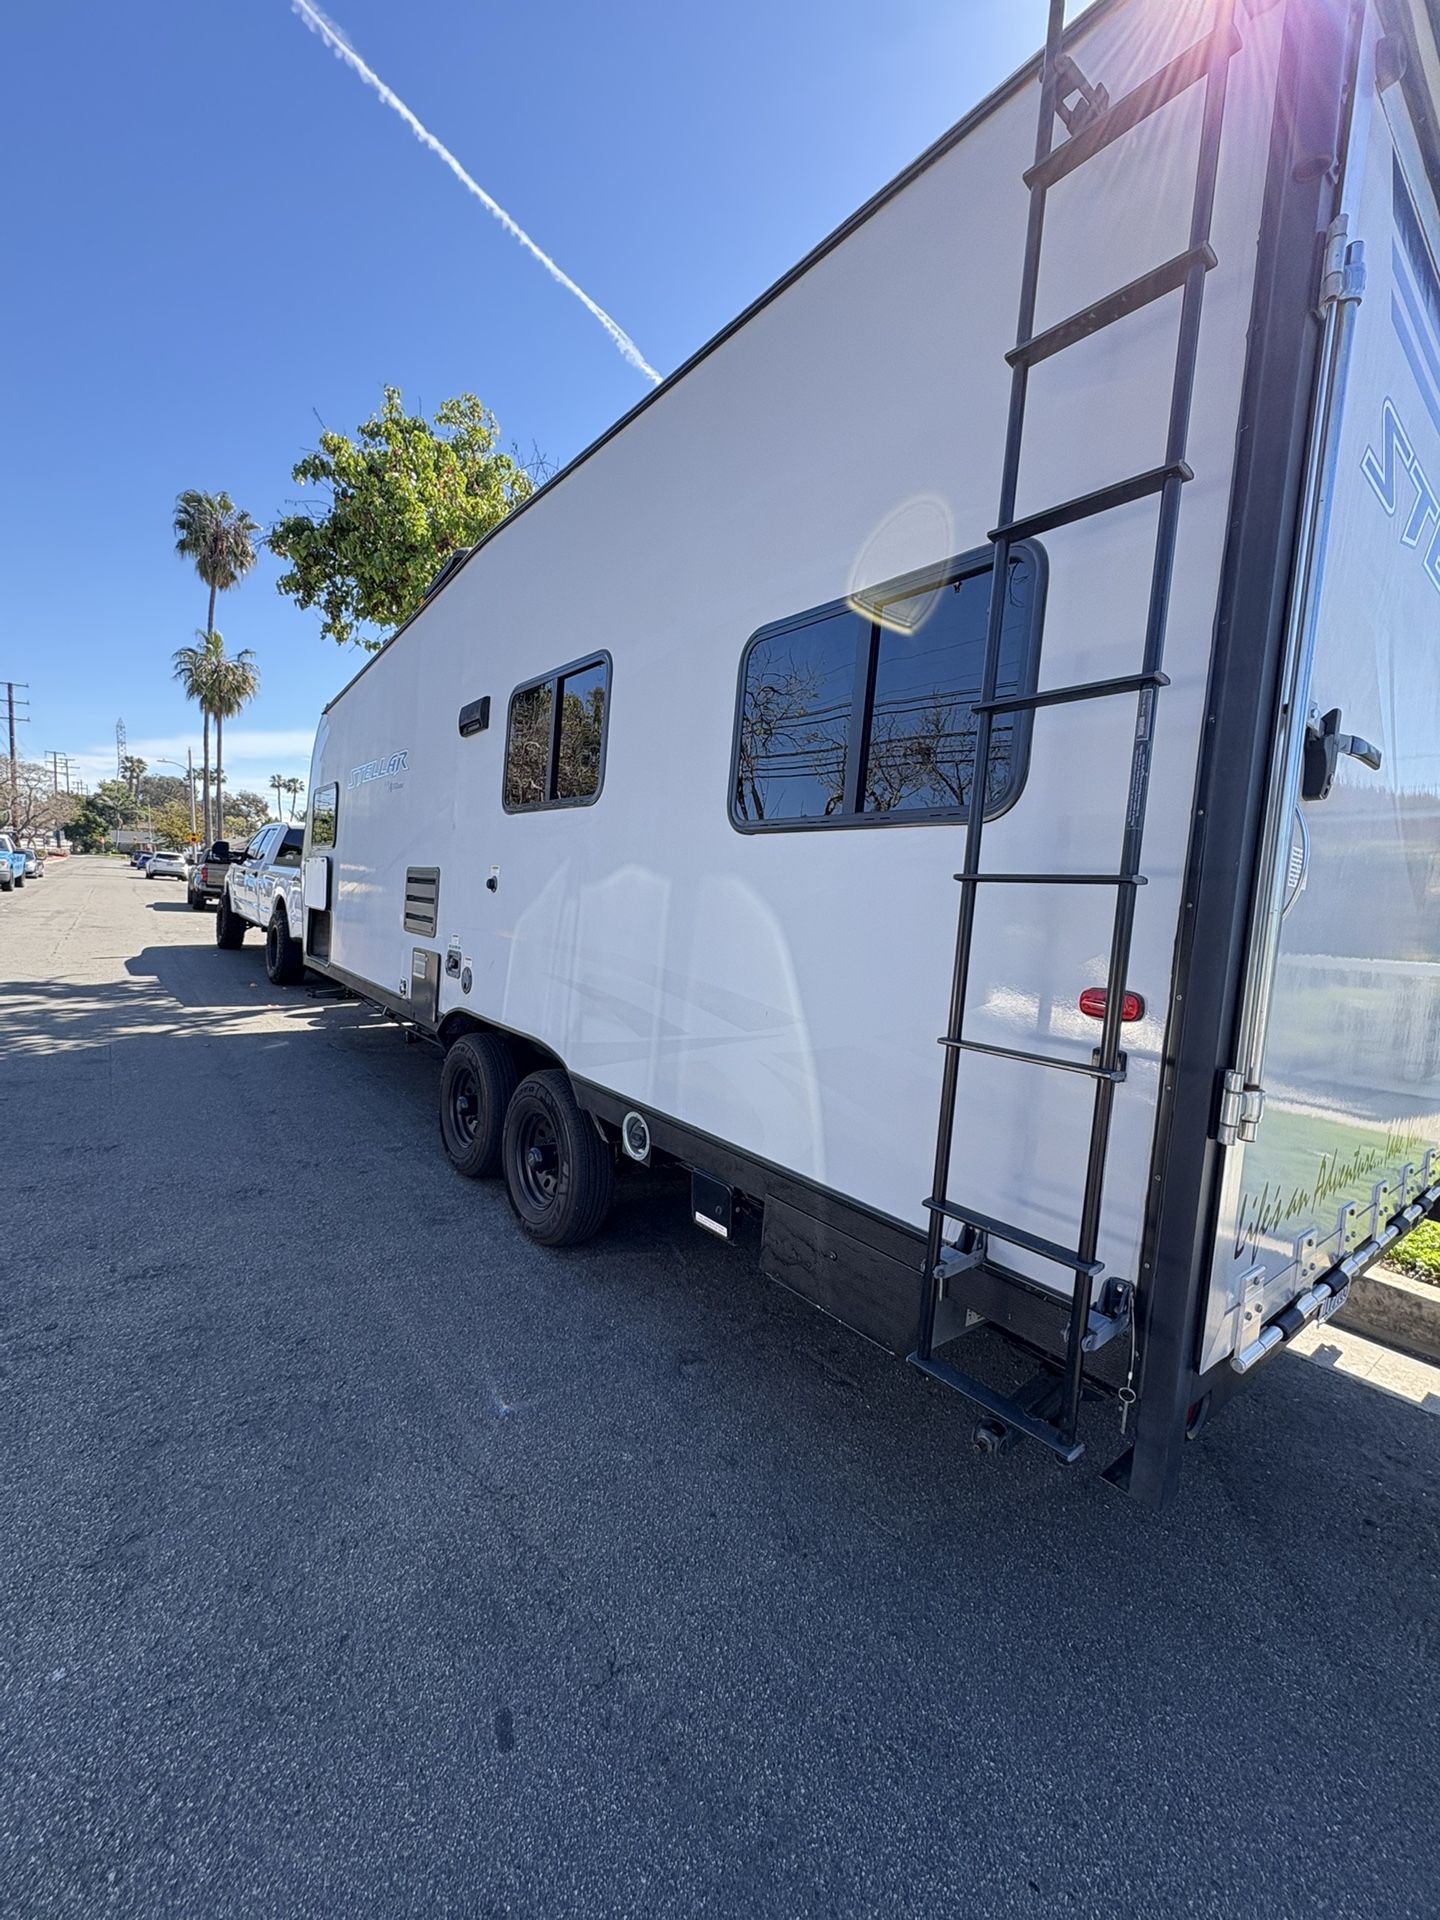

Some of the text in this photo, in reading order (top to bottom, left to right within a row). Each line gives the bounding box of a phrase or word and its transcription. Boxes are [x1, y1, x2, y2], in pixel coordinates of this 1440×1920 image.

[347, 750, 409, 790] STELLAR
[1233, 1181, 1283, 1265] Life's
[1286, 1187, 1310, 1220] an
